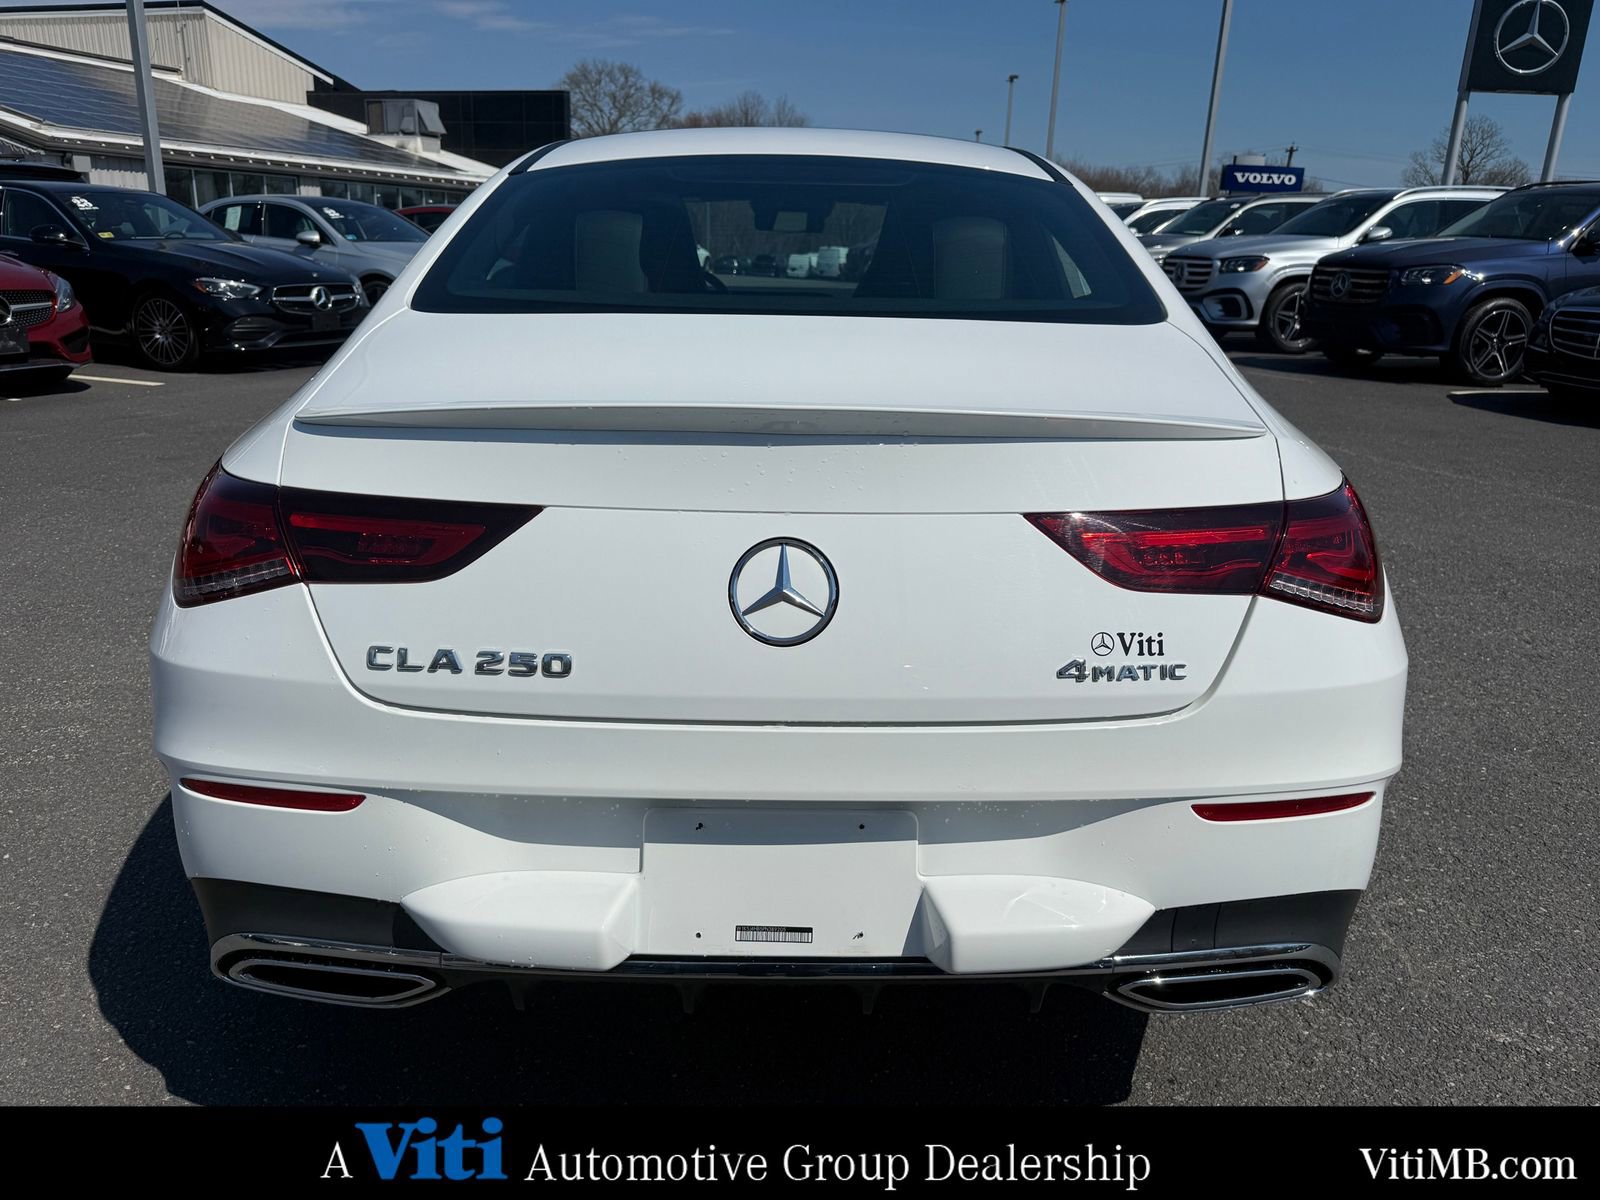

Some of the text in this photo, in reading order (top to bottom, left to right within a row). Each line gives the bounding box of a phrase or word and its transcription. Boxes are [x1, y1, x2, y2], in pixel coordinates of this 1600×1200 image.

[1233, 171, 1297, 186] VOLVO
[1116, 631, 1165, 657] Viti
[366, 645, 573, 679] CLA 250
[1056, 658, 1188, 683] 4MATIC
